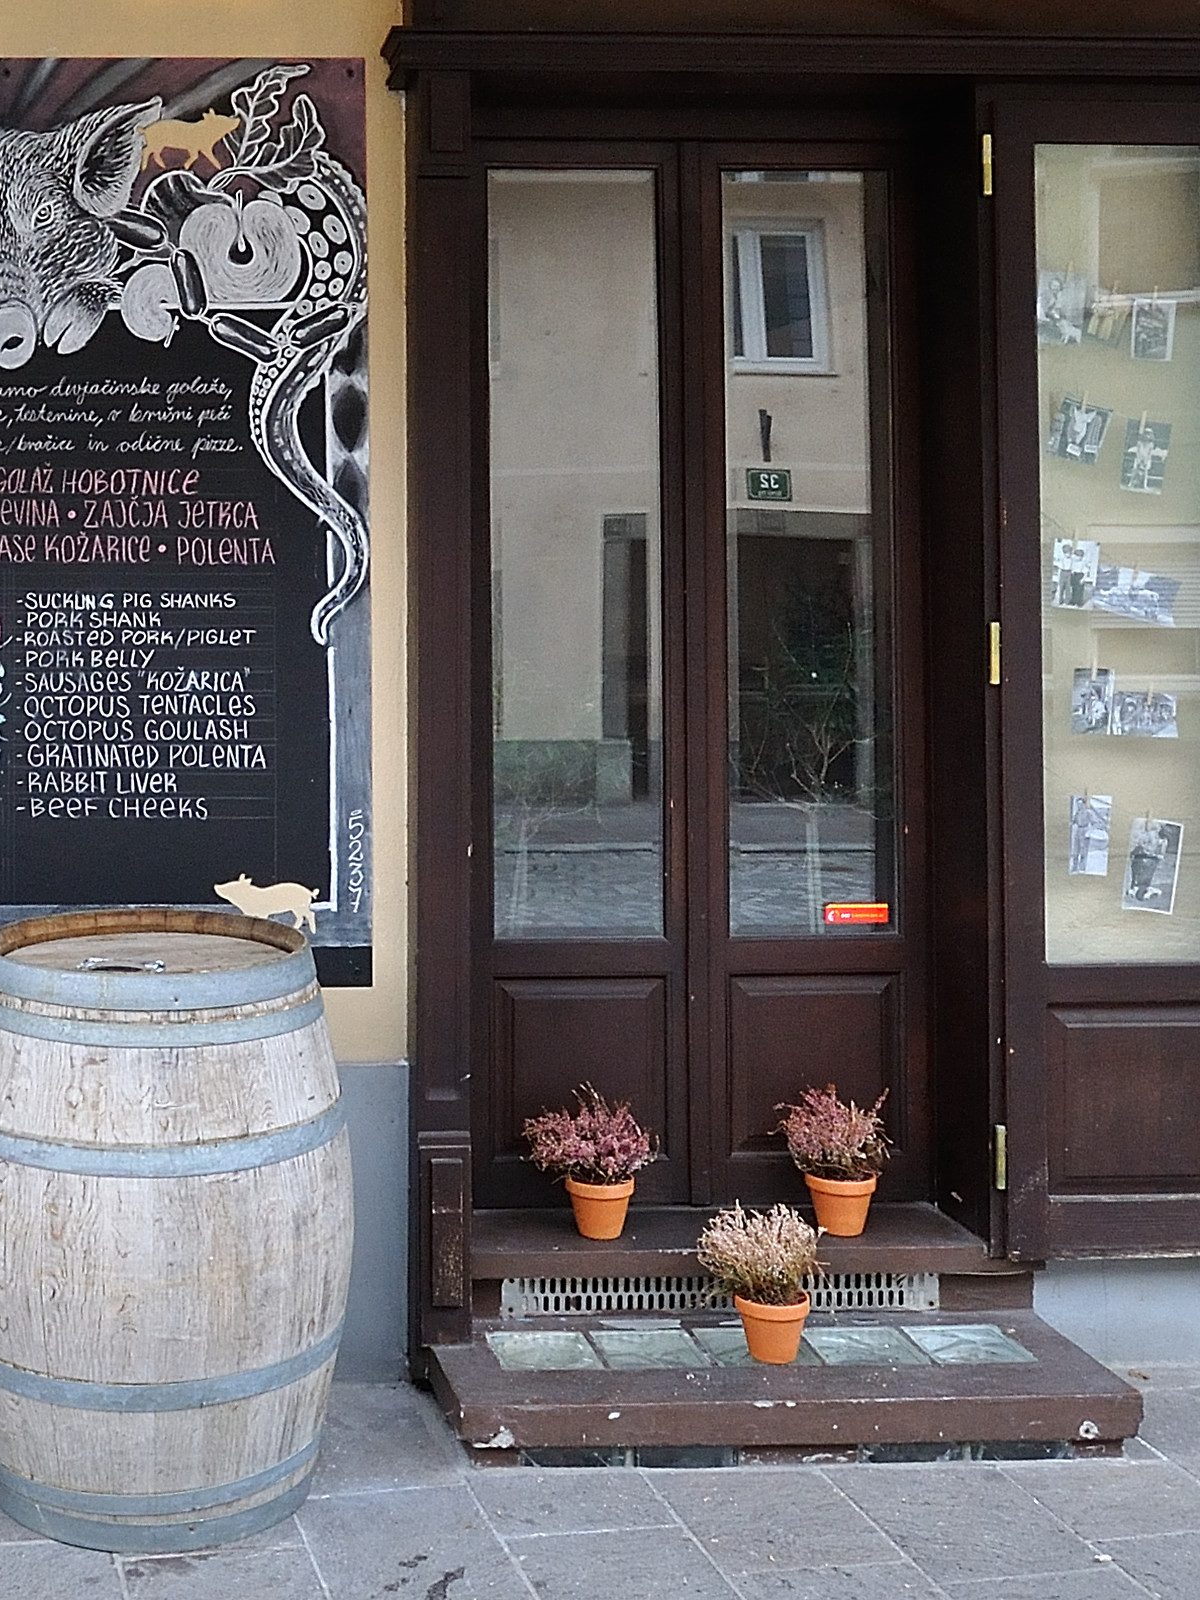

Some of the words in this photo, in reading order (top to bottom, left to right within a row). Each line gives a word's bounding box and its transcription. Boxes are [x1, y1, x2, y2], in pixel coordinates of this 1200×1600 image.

[89, 434, 108, 451] in
[84, 493, 168, 528] ZAJČJA
[123, 593, 152, 608] PIG
[160, 593, 236, 608] SHANKS
[27, 611, 83, 631] PORK
[87, 609, 161, 628] SHANK
[26, 650, 84, 668] PORK
[24, 695, 130, 718] OCTOPUS
[25, 717, 133, 744] OCTOPUS
[144, 719, 247, 741] GOULASH
[29, 771, 108, 794] RABBIT
